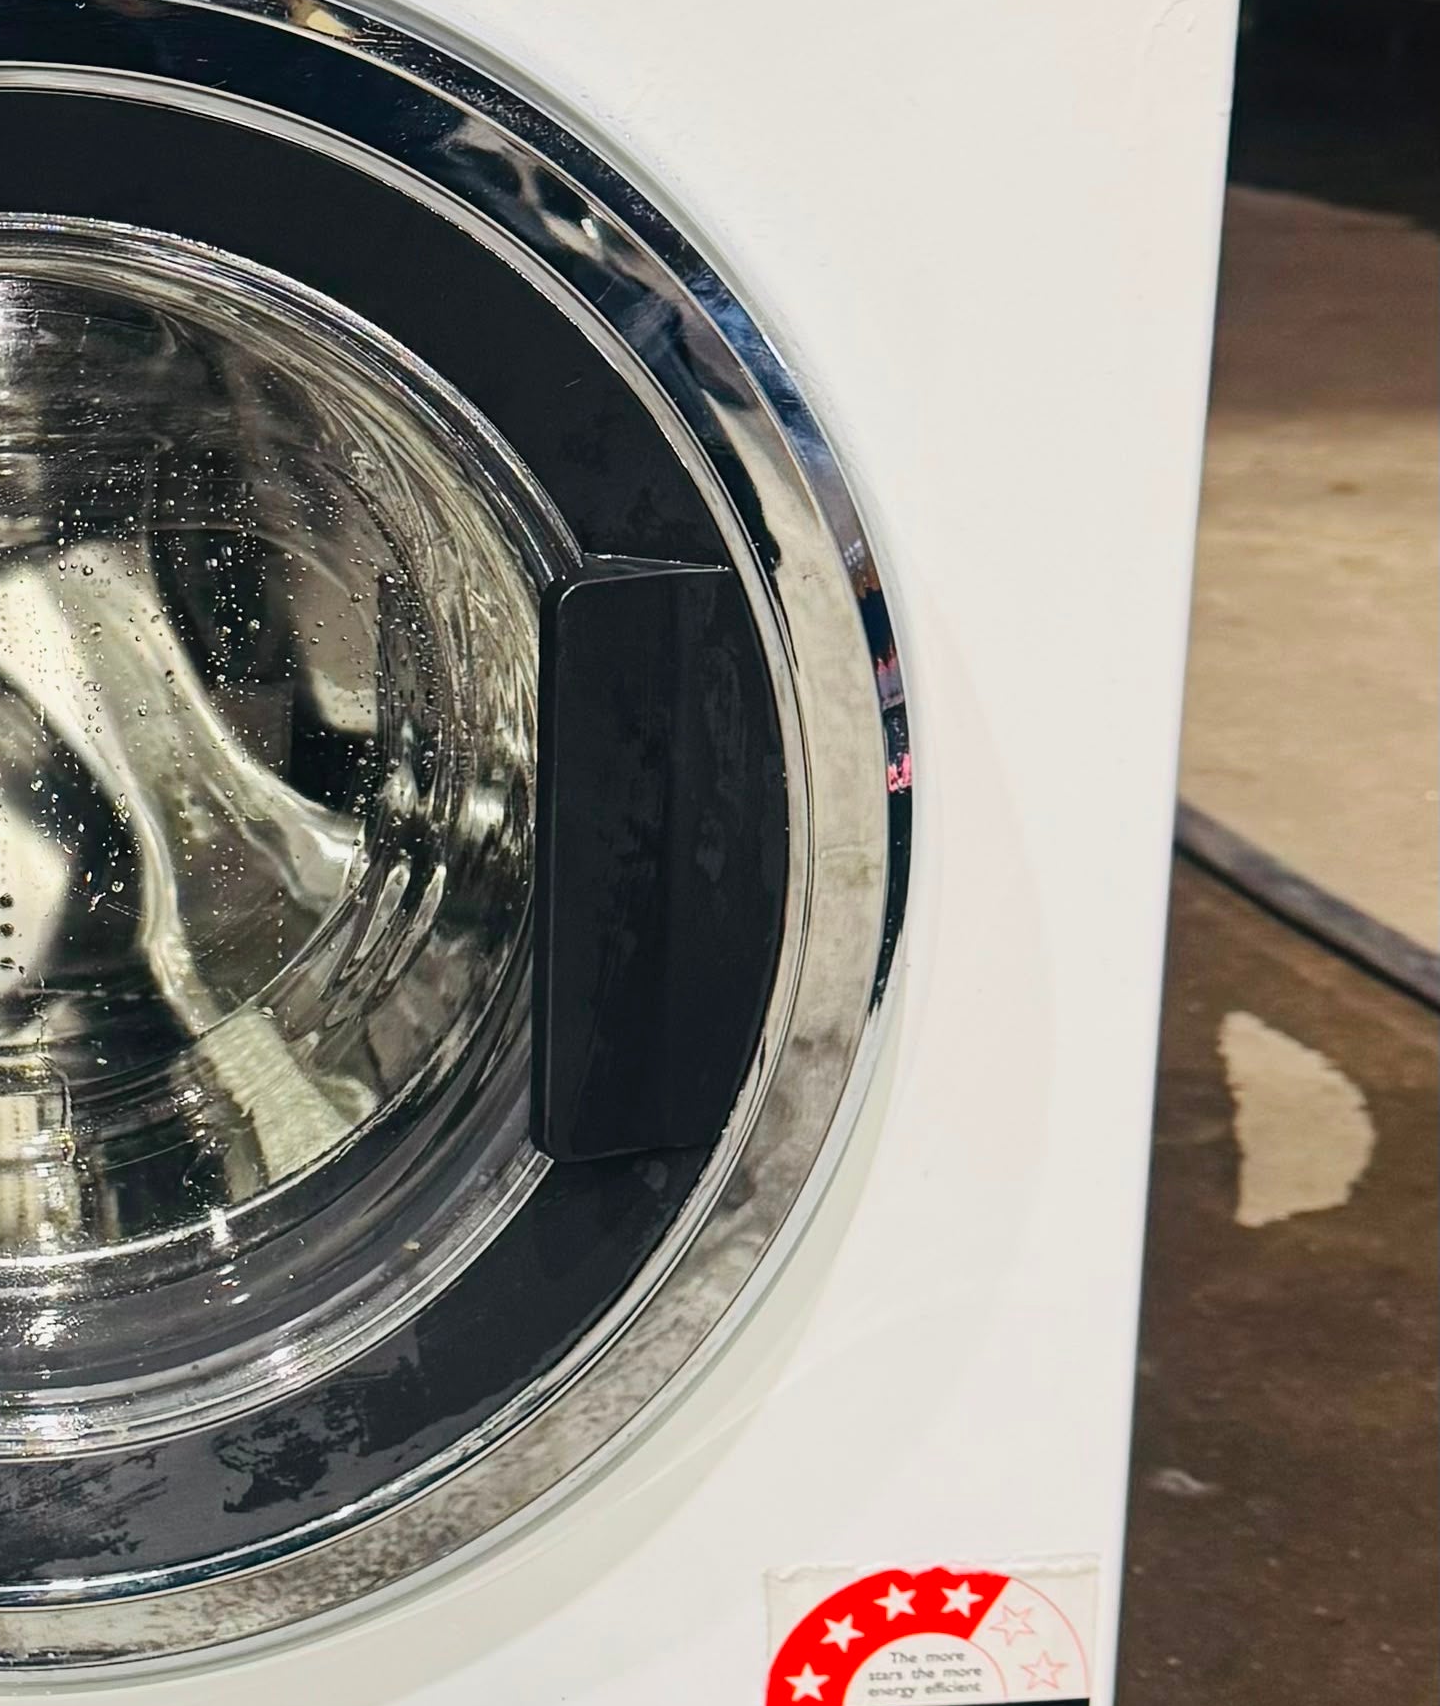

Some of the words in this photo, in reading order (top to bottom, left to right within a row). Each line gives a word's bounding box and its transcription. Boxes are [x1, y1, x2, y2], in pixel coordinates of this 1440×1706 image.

[890, 1652, 917, 1663] The
[926, 1653, 965, 1662] more
[869, 1672, 902, 1680] stars
[912, 1668, 934, 1679] the
[944, 1667, 982, 1677] more
[868, 1686, 916, 1698] energy
[926, 1682, 982, 1693] efficient
